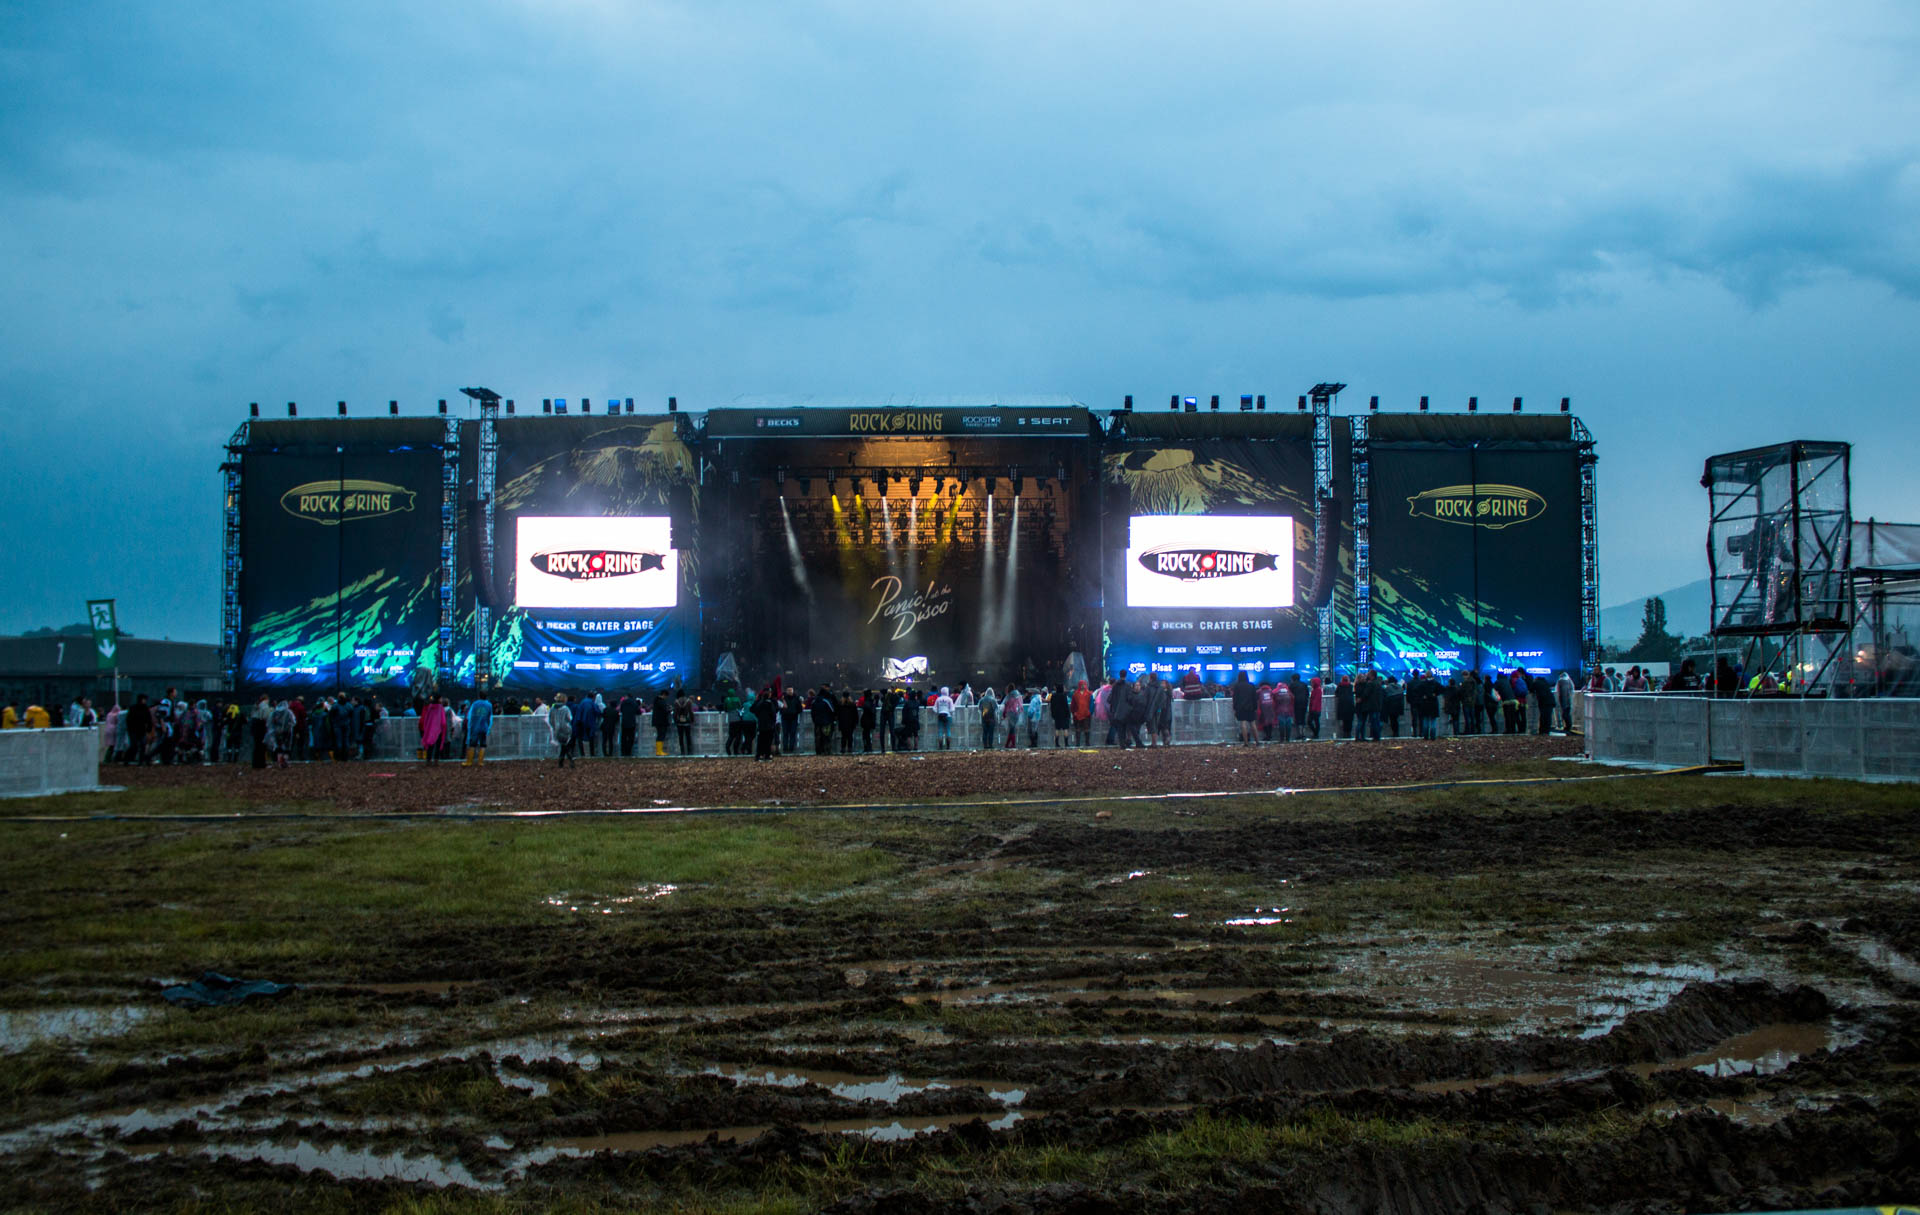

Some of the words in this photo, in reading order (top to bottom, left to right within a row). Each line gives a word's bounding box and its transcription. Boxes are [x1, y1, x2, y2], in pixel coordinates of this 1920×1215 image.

[850, 413, 890, 431] ROCK
[906, 412, 943, 431] RING
[1031, 417, 1072, 425] SEAT
[300, 495, 340, 512] ROCK
[357, 494, 391, 511] RING
[1435, 499, 1473, 517] ROCK
[1492, 499, 1528, 516] RING
[548, 553, 590, 572] ROCK
[604, 553, 643, 572] RING
[1158, 553, 1200, 572] ROCK
[1216, 553, 1255, 572] RING
[867, 575, 935, 625] Panic!
[582, 621, 620, 631] CRATER
[623, 621, 654, 631] STAGE
[891, 600, 949, 641] Disco
[1199, 621, 1239, 630] CRATER
[1242, 620, 1273, 630] STAGE
